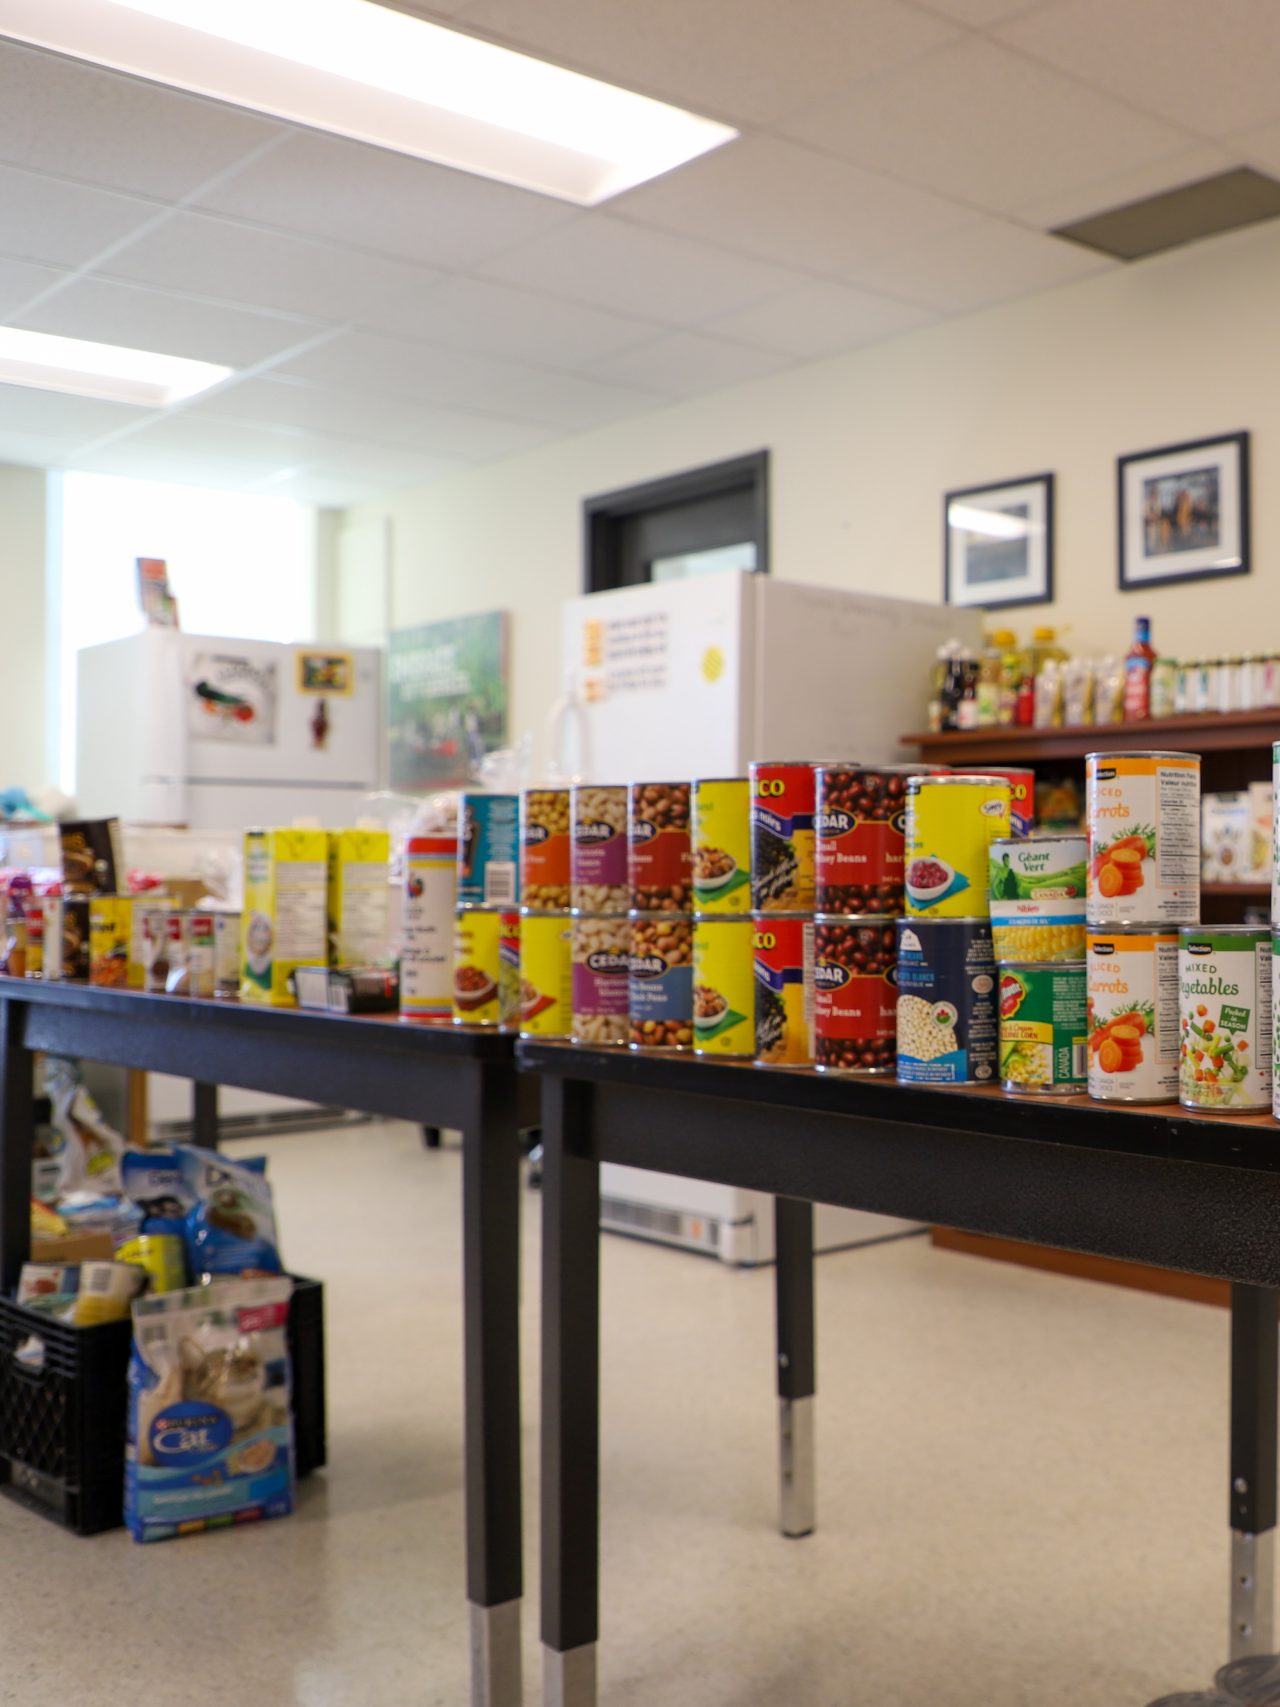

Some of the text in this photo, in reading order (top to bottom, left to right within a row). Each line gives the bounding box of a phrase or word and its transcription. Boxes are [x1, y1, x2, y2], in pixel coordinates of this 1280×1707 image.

[1018, 852, 1050, 862] Géant
[1023, 861, 1046, 872] Vert
[1185, 963, 1217, 974] MIXED
[1220, 1020, 1247, 1030] SEASON
